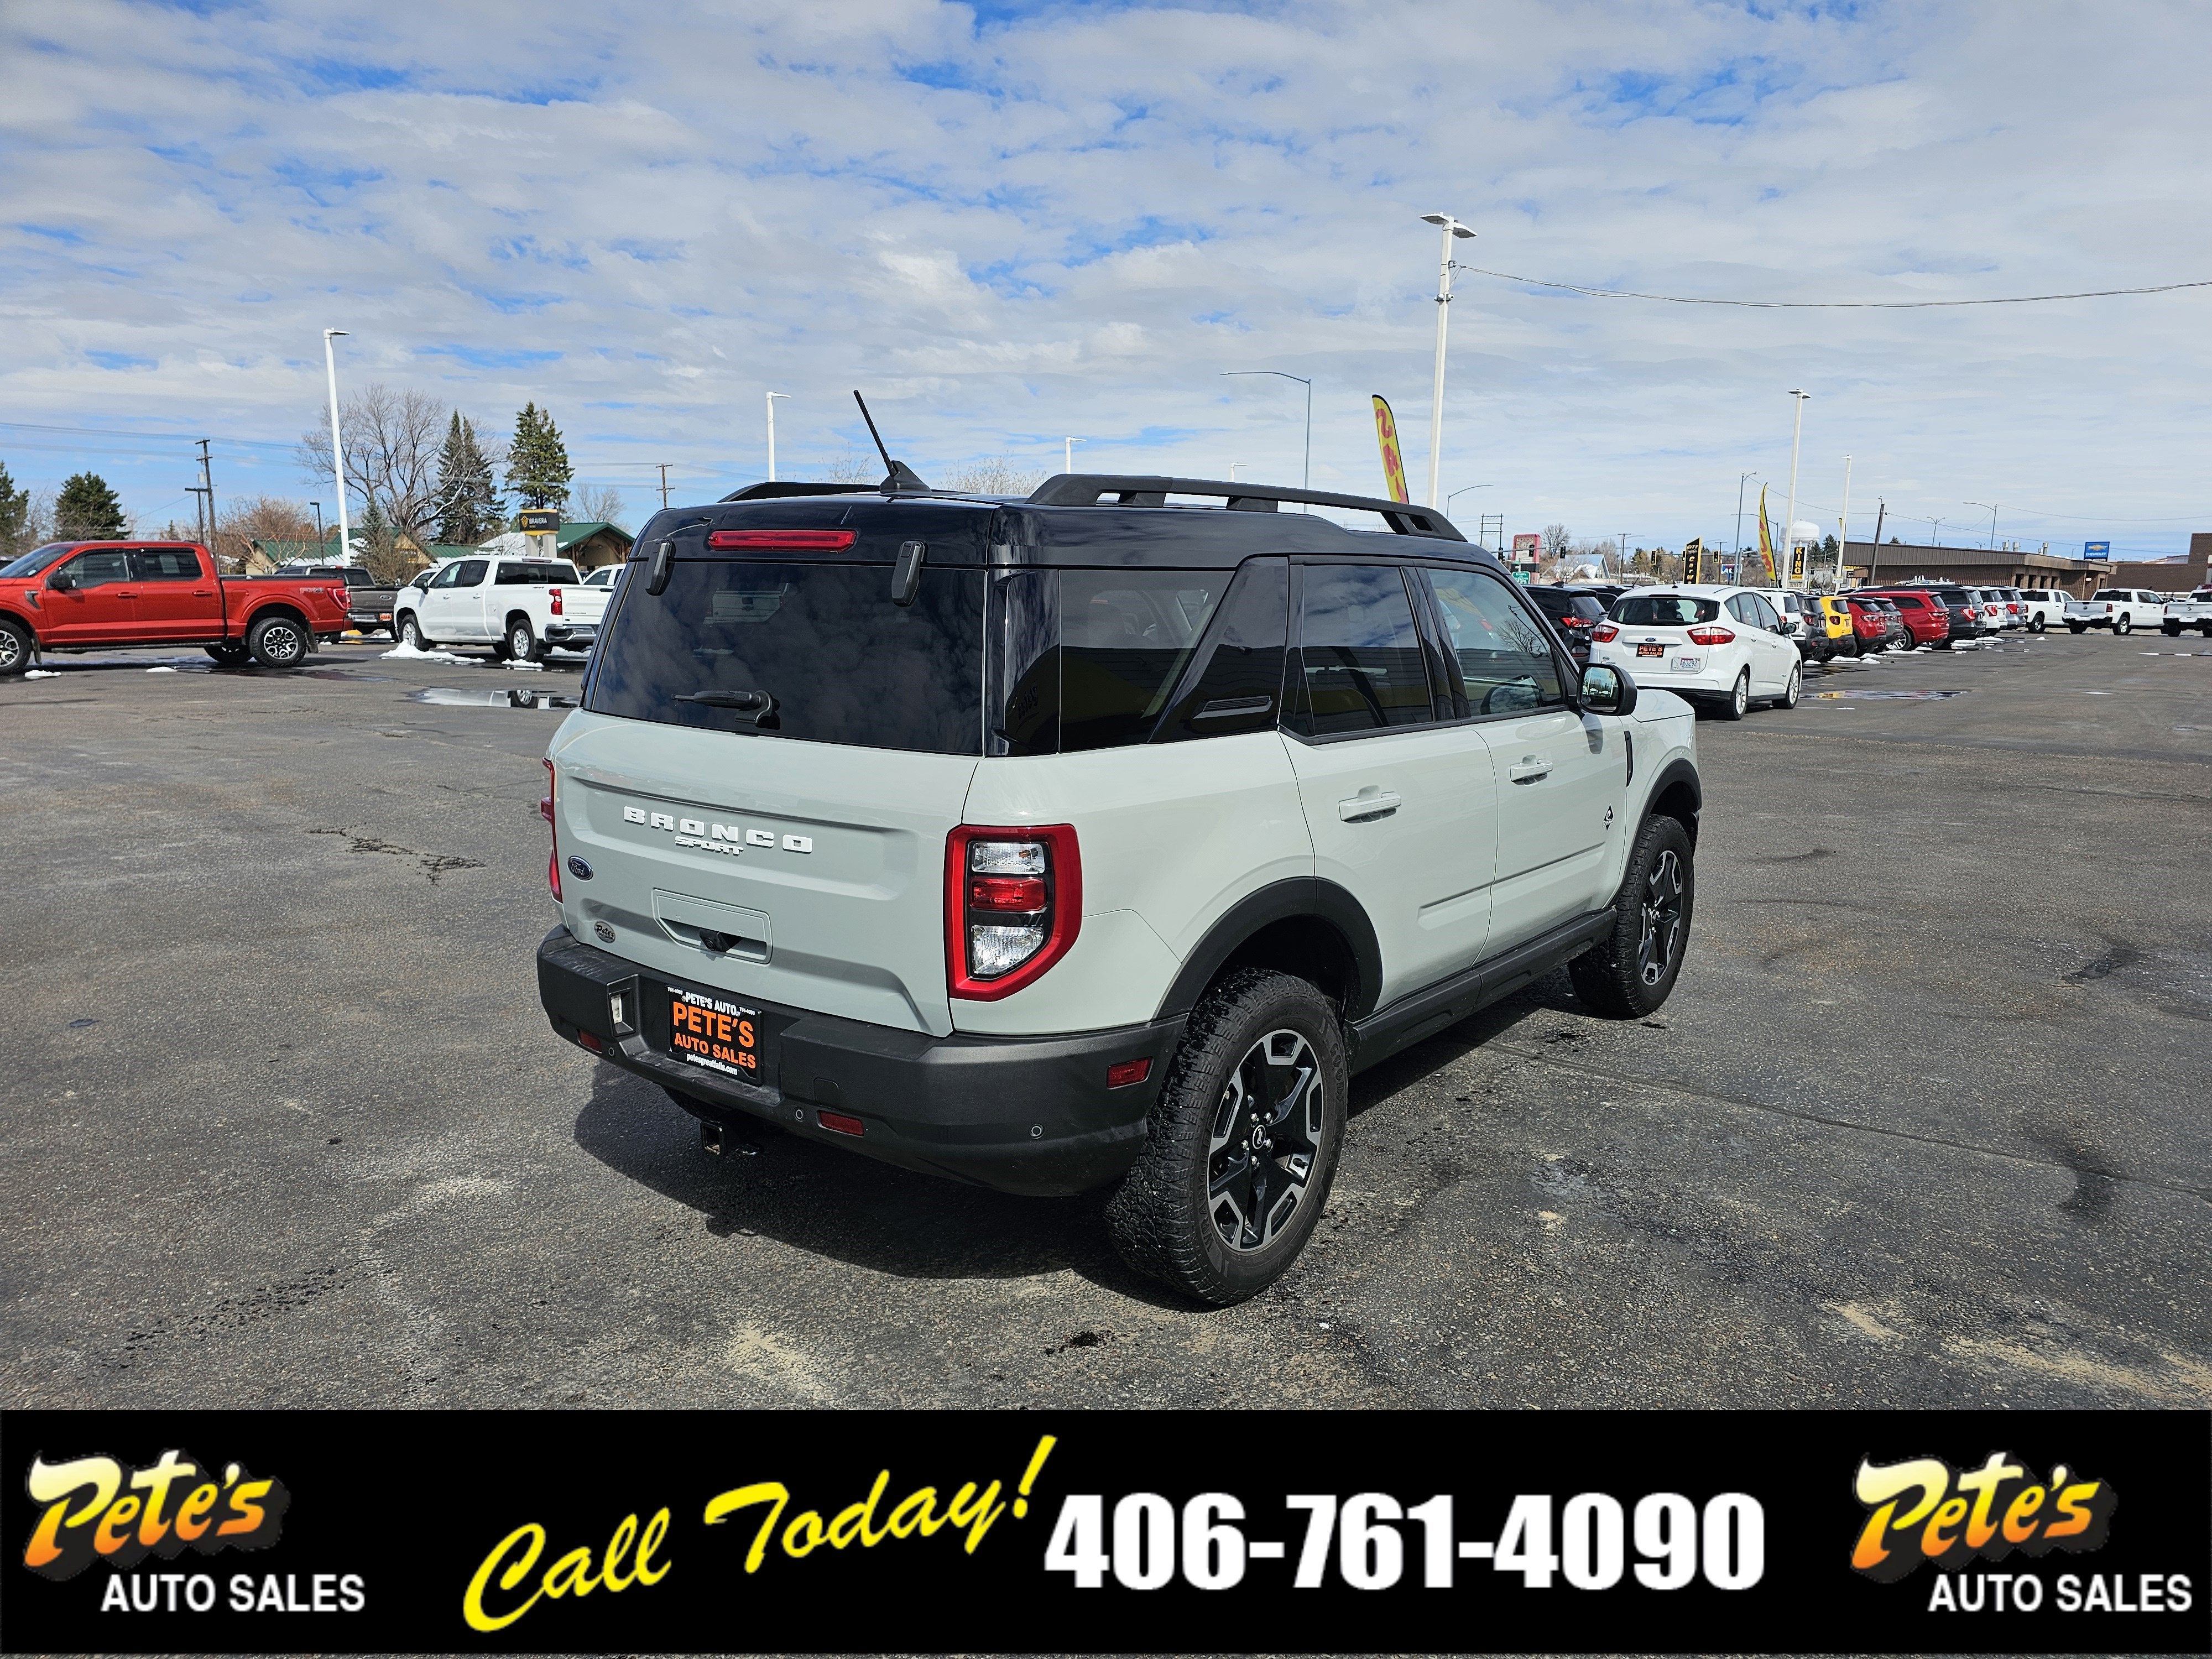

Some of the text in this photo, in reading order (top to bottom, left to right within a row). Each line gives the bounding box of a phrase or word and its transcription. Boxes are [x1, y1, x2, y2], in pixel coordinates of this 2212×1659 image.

[1794, 547, 1803, 573] KING
[624, 806, 813, 854] BRONCO
[675, 836, 744, 855] SPORT
[571, 861, 585, 875] Ford
[596, 924, 614, 937] Pete's
[686, 992, 713, 1009] PETE'S
[673, 1001, 754, 1047] PETE'S
[674, 1032, 756, 1068] AUTO SALES
[686, 1053, 738, 1075] petesgreatfalls.com
